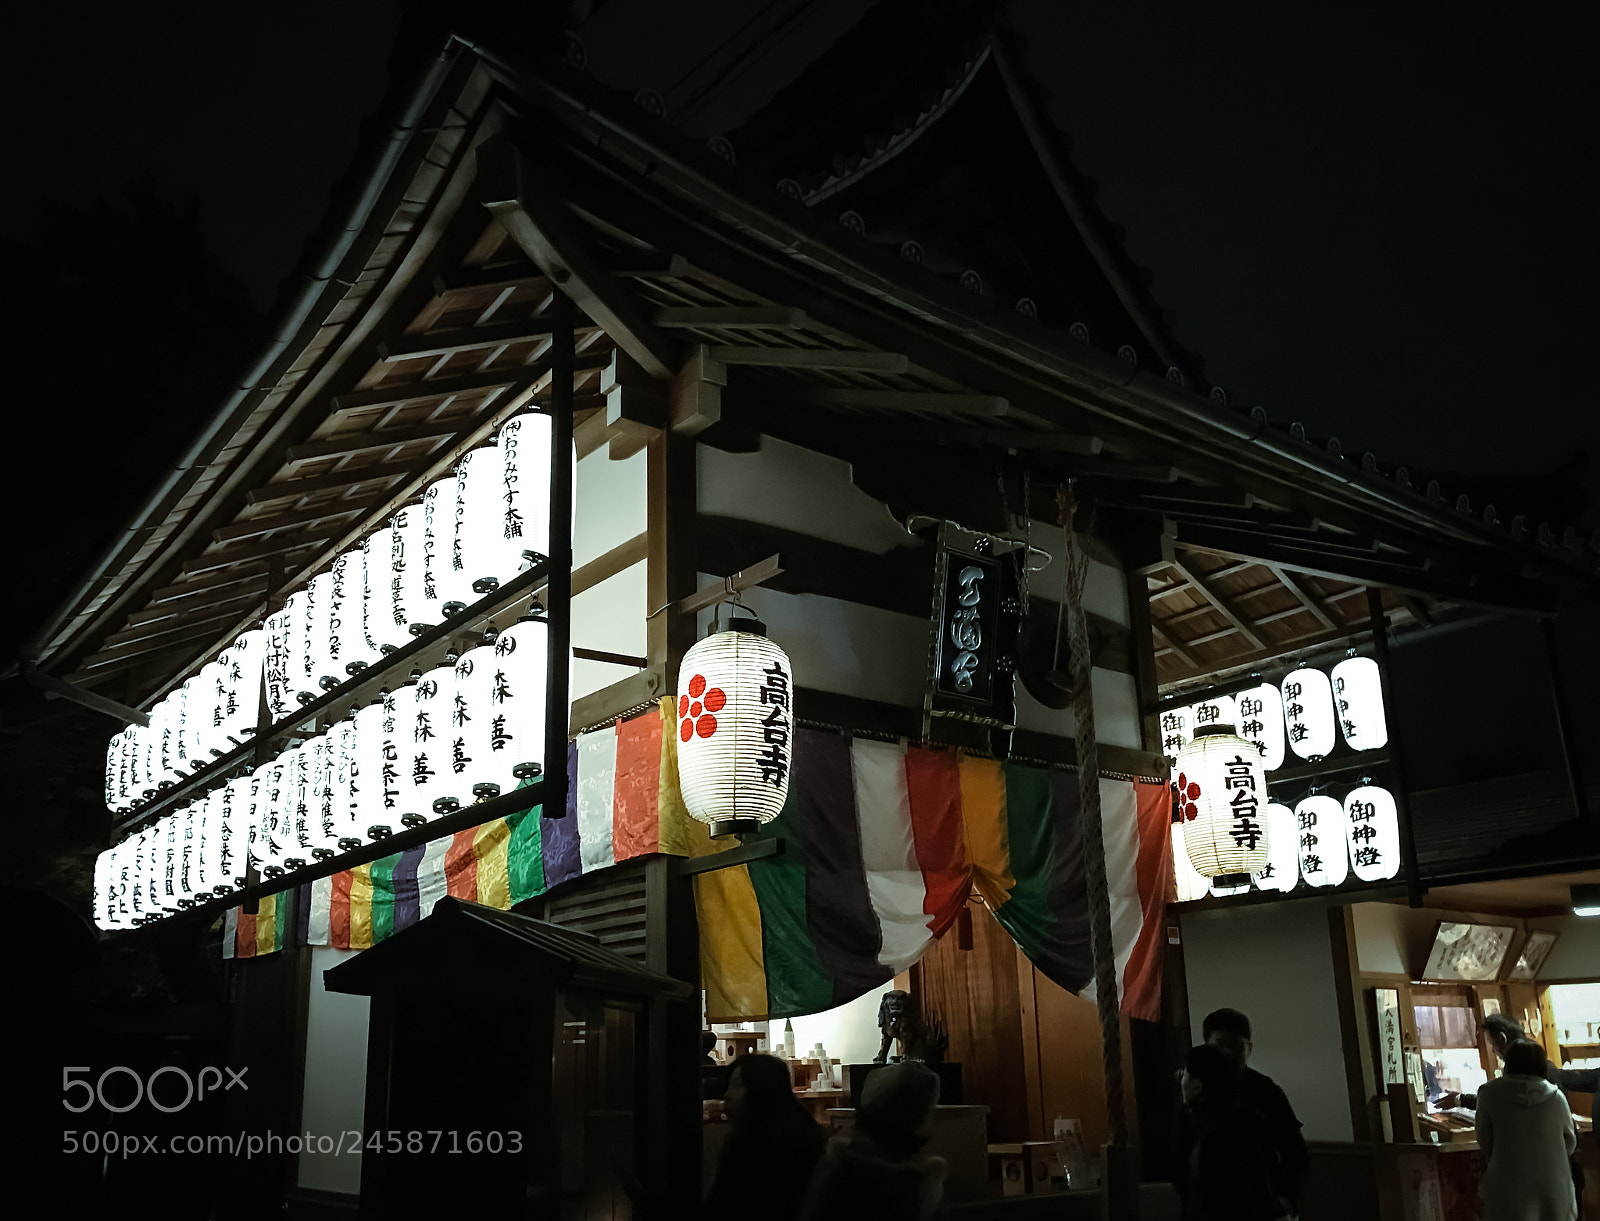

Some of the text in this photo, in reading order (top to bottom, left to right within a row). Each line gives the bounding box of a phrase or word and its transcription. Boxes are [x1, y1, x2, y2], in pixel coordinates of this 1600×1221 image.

[756, 661, 789, 788] 高台寺
[1225, 755, 1263, 850] 高台寺
[1350, 800, 1383, 867] 御神燈
